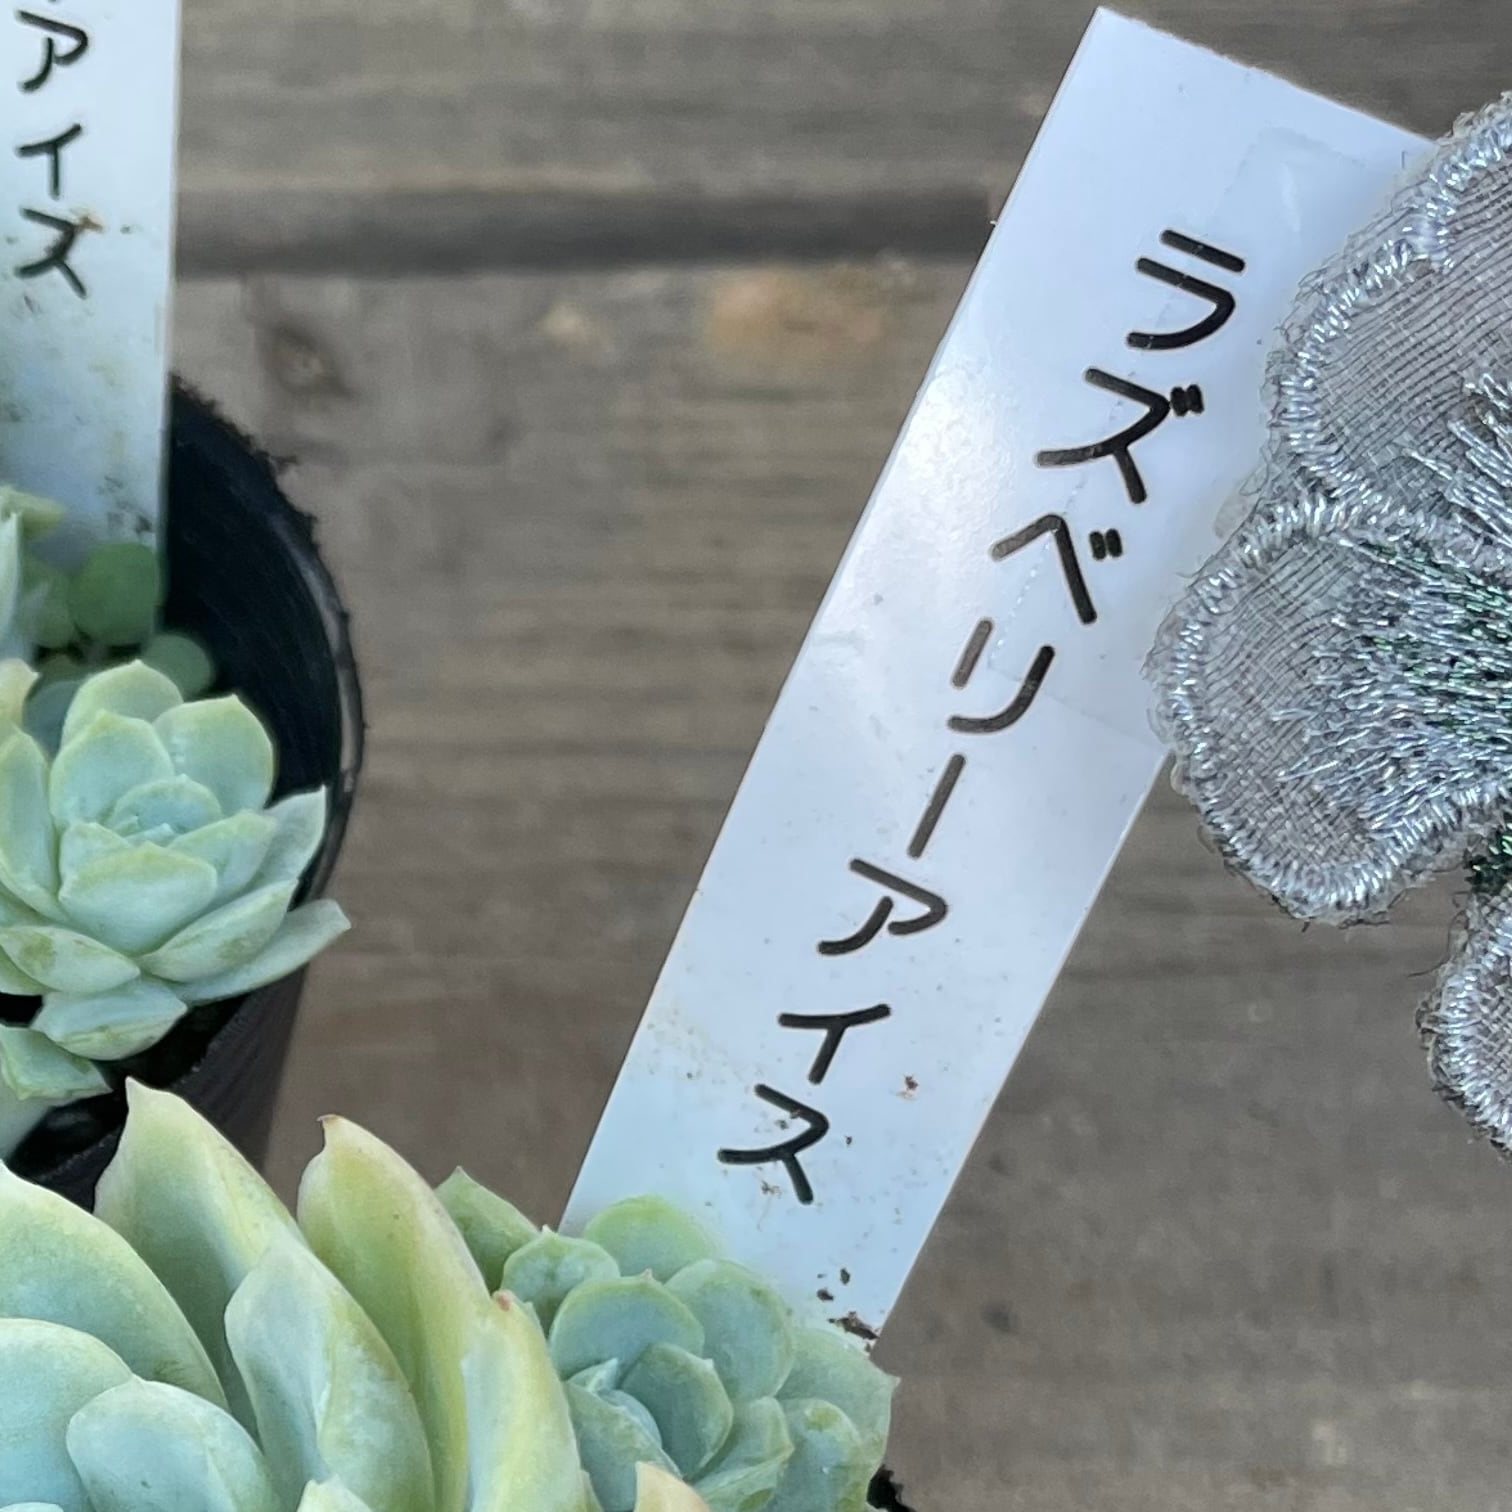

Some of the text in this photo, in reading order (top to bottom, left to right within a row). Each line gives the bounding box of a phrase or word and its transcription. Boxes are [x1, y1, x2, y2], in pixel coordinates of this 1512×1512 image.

[15, 0, 90, 300] アイス
[717, 228, 1246, 1205] ラズベリーアイス
